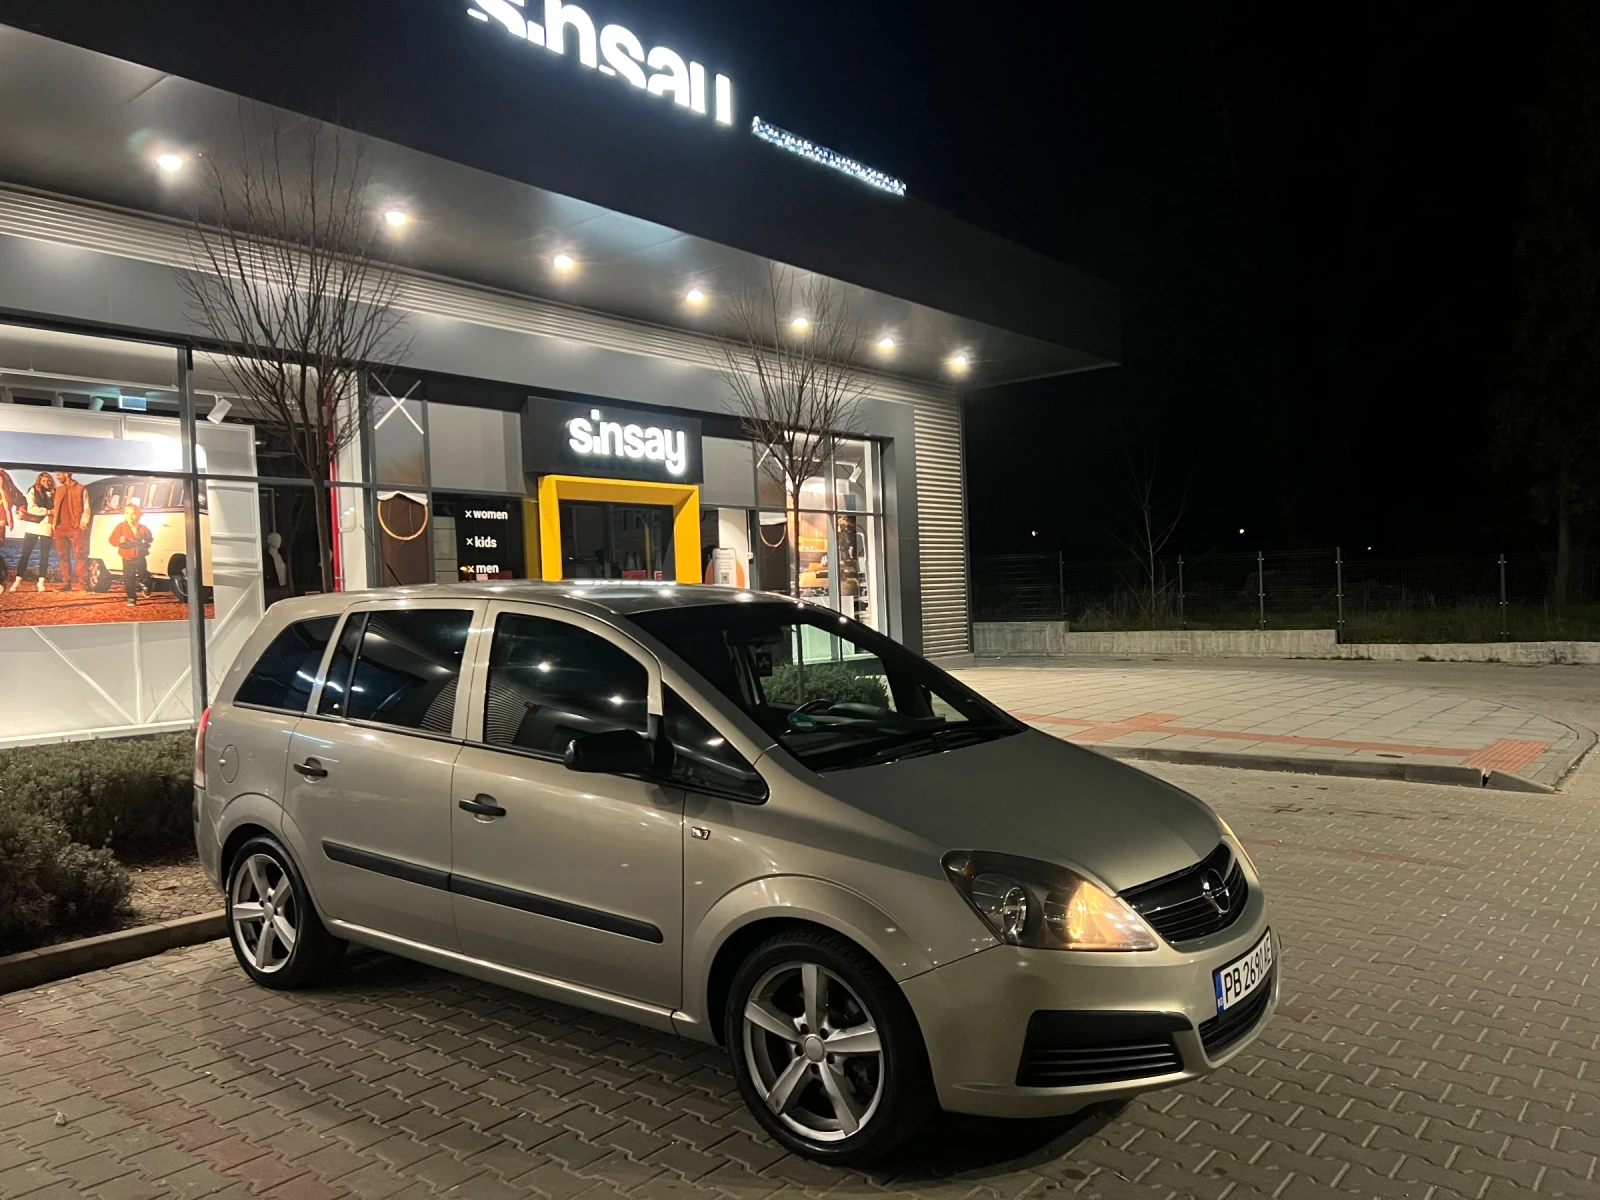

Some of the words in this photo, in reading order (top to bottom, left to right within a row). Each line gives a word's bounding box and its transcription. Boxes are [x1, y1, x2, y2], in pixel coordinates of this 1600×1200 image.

[568, 409, 686, 475] sinsay
[473, 510, 508, 520] women
[474, 535, 498, 548] kids
[475, 564, 499, 573] men
[1224, 967, 1242, 1003] PB
[1243, 948, 1263, 990] 2690
